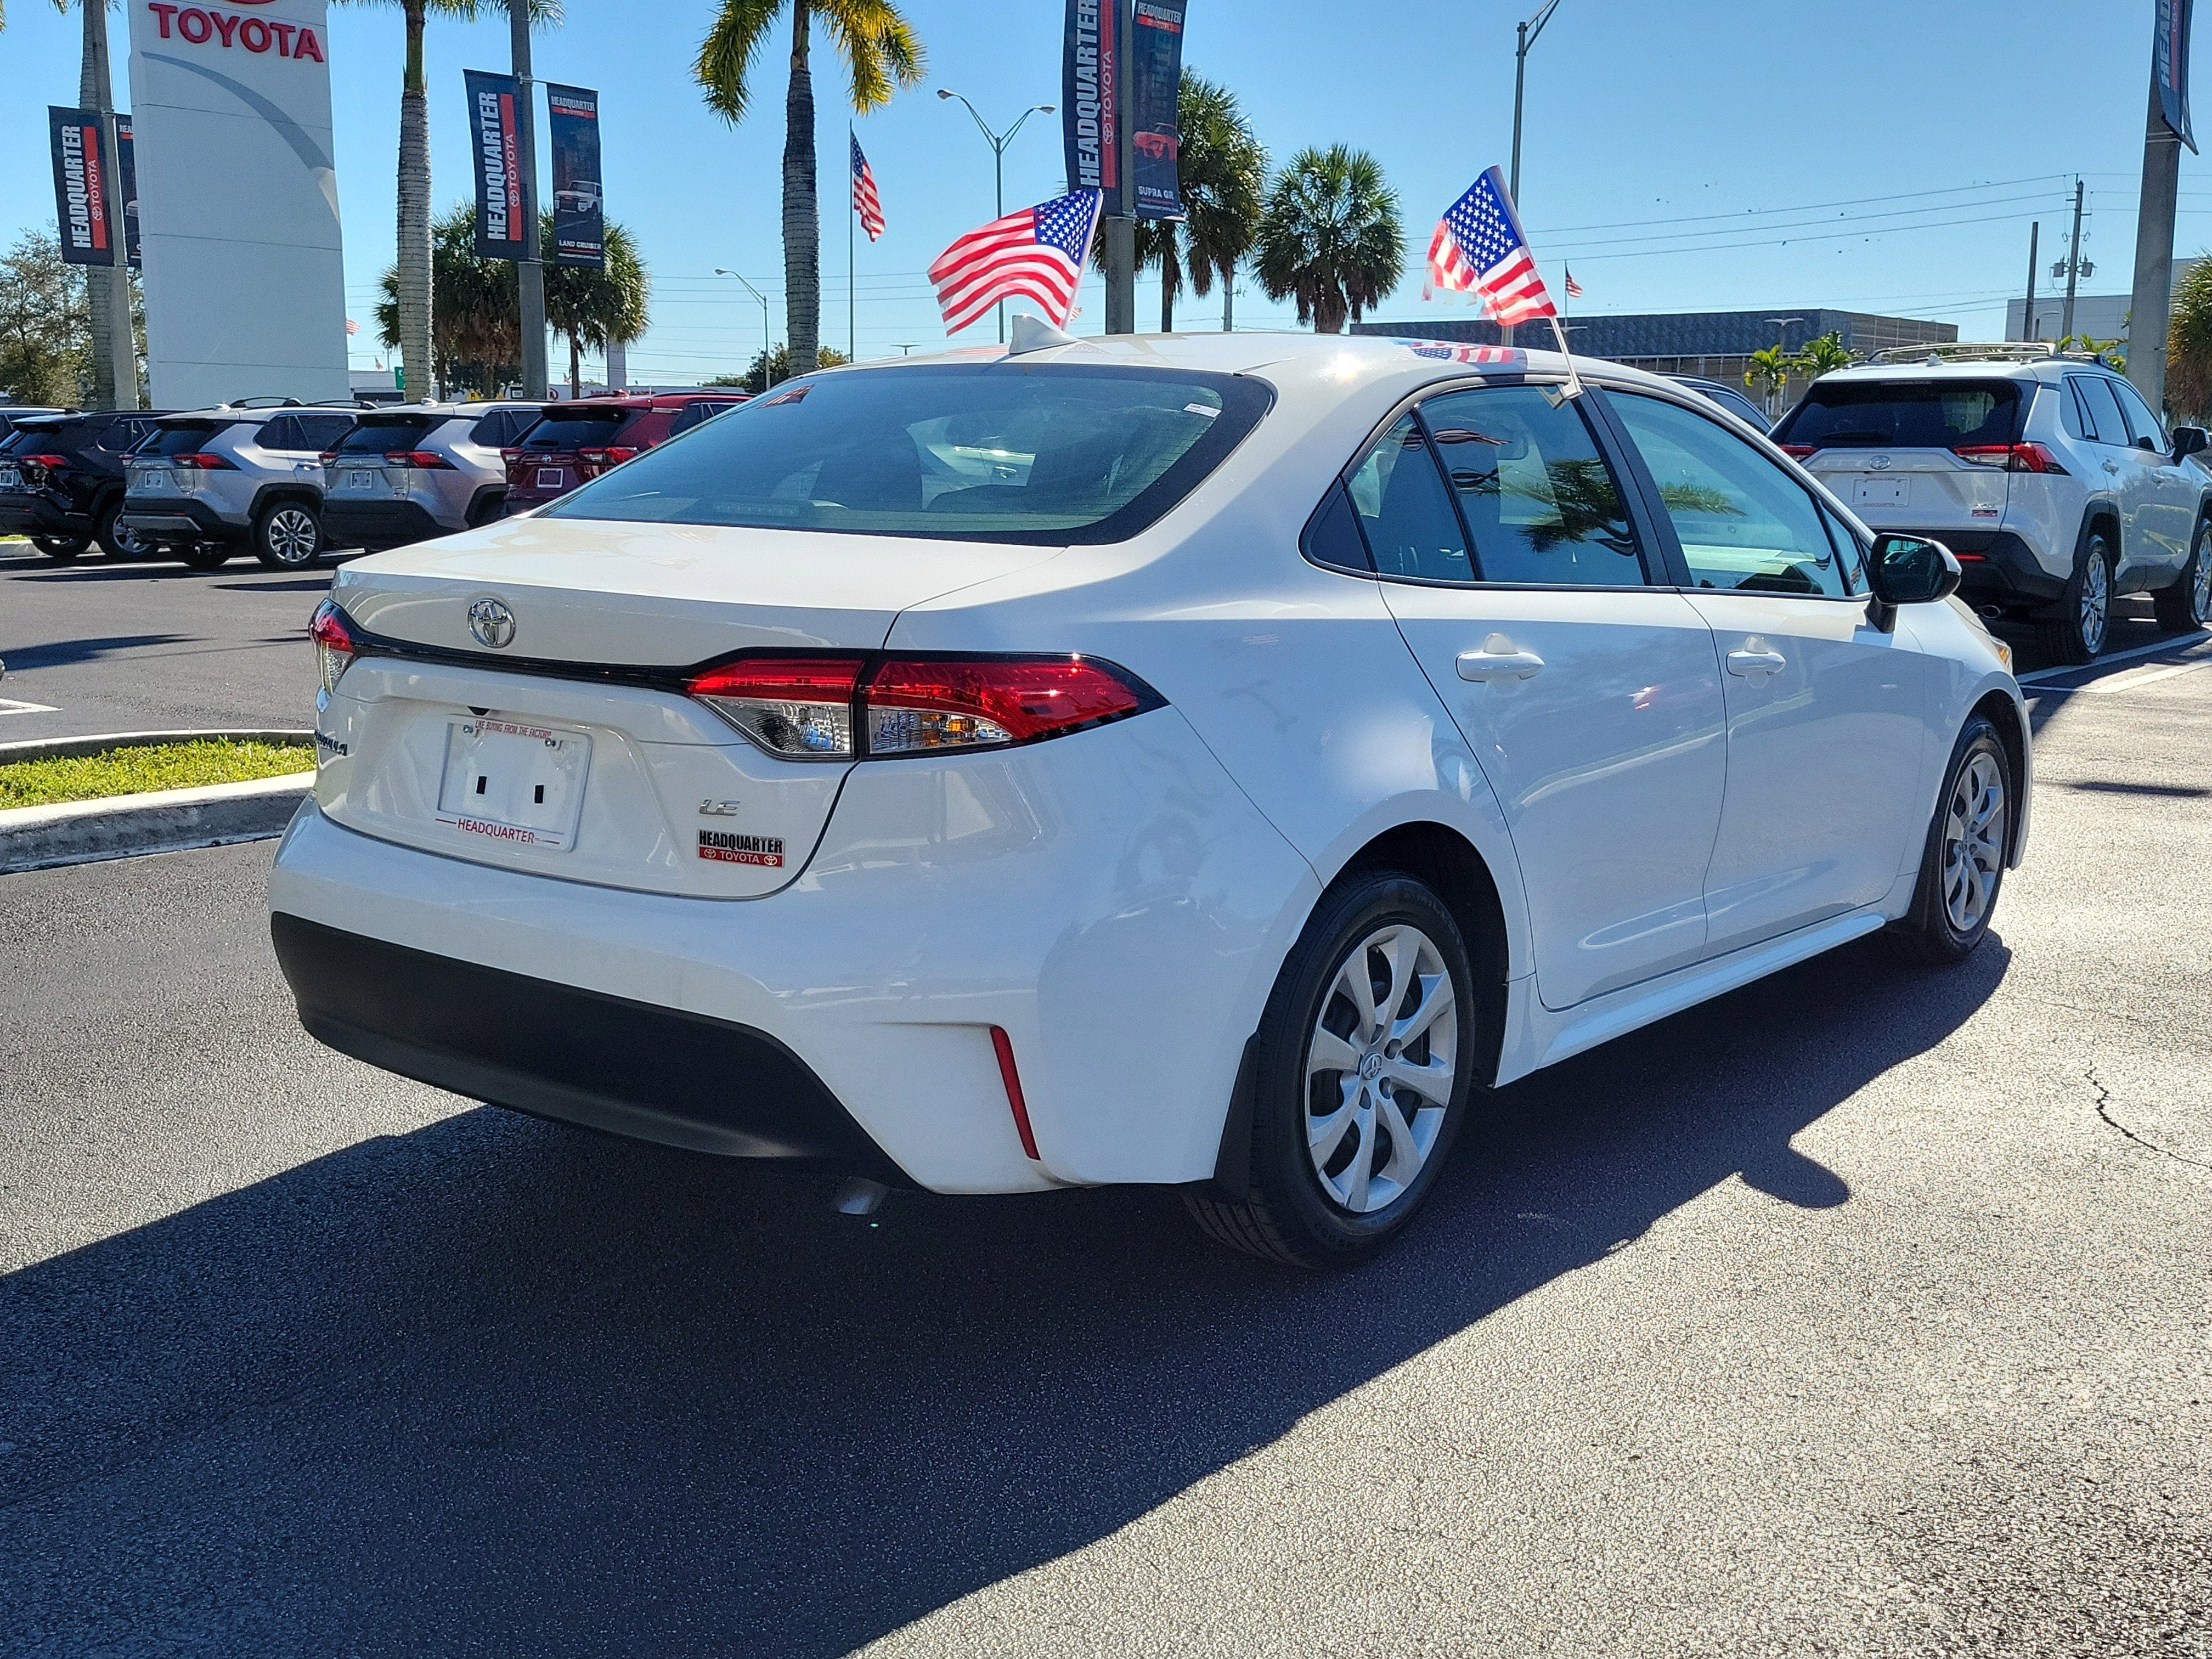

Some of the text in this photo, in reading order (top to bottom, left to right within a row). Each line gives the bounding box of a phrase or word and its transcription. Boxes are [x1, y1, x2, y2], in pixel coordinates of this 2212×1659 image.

[1138, 2, 1182, 24] HEADQUARTER
[149, 3, 325, 63] TOYOTA
[1076, 0, 1101, 187] HEADQUARTER
[1103, 50, 1111, 121] TOYOTA
[551, 95, 595, 112] HEADQUARTER
[478, 92, 506, 240] HEADQUARTER
[506, 134, 518, 188] TOYOTA
[61, 125, 92, 248] HEADQUARTER
[87, 160, 101, 205] TOYOTA
[1138, 186, 1174, 200] SUPRA GR
[576, 241, 601, 250] CRUISER
[475, 719, 485, 729] LIKE
[486, 721, 503, 732] BUYING
[504, 724, 518, 734] FROM
[518, 726, 528, 736] THE
[699, 799, 740, 816] LE
[458, 818, 534, 844] HEADQUARTER
[699, 830, 783, 854] HEADQUARTER
[720, 850, 760, 864] TOYOTA
